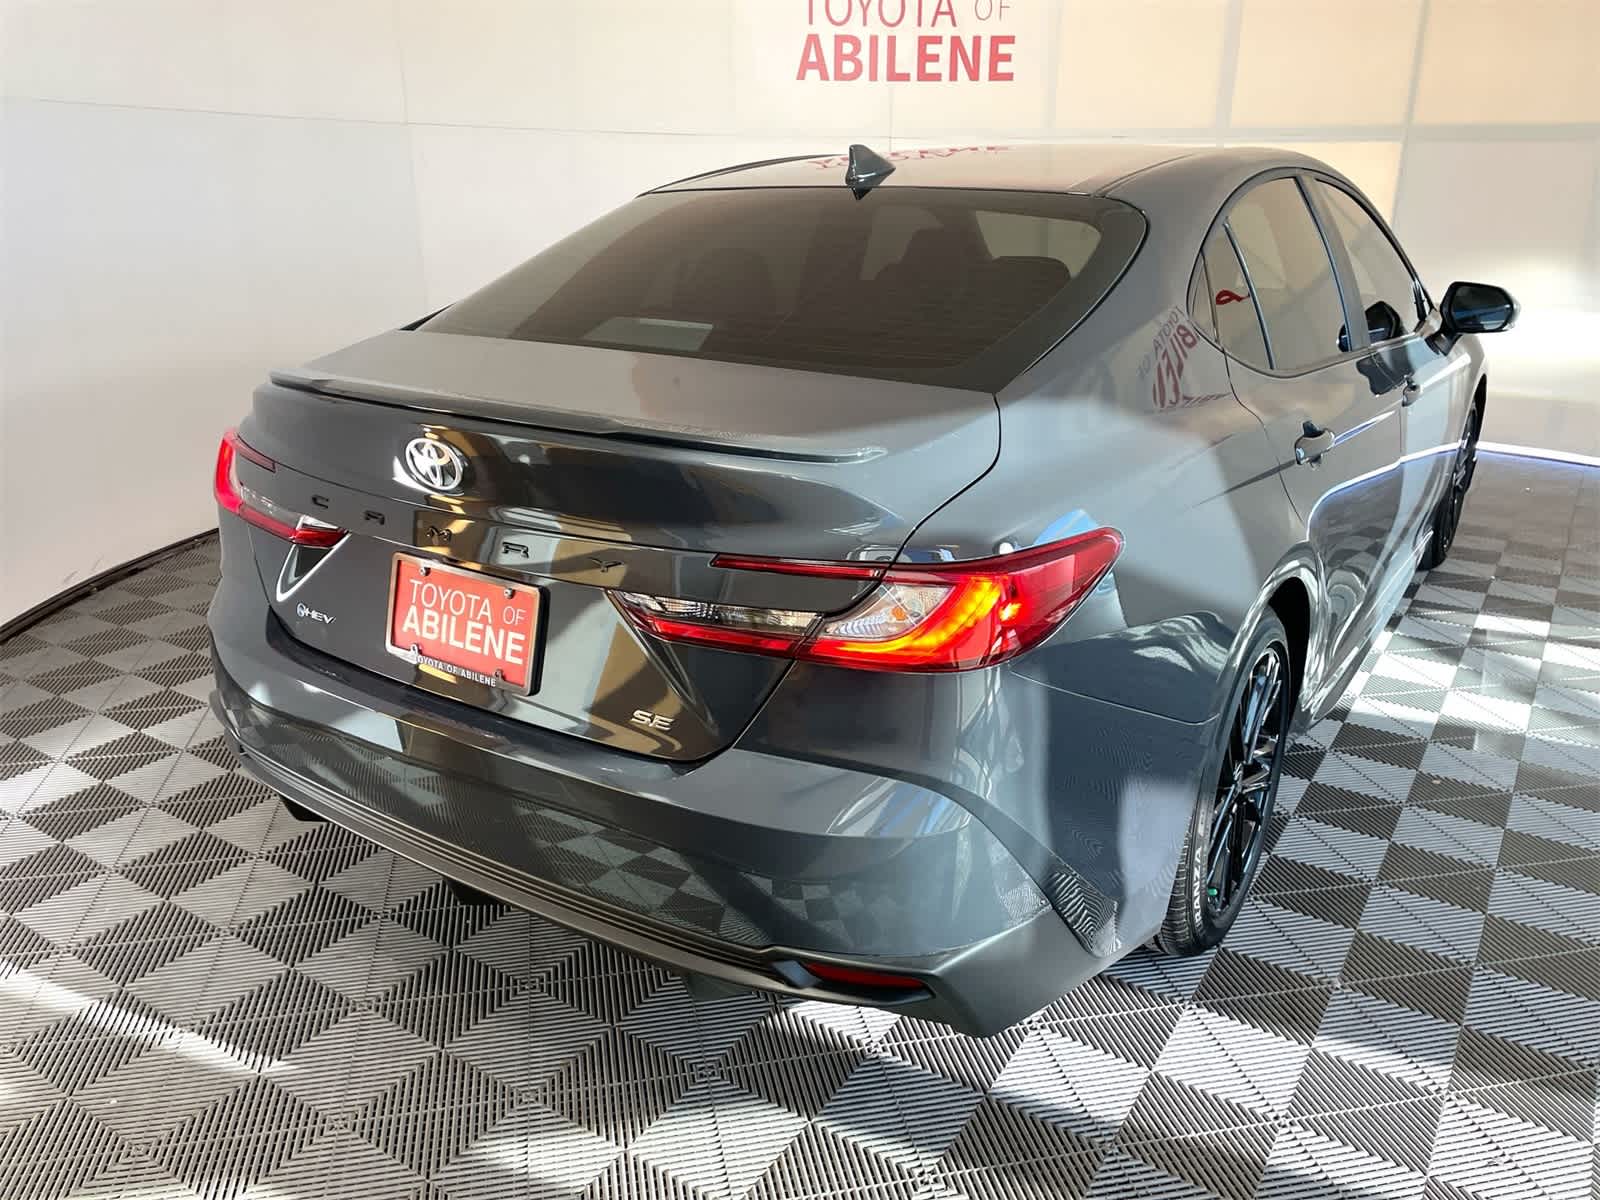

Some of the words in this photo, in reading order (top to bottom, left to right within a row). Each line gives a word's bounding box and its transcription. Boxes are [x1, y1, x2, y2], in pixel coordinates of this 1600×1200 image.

[807, 0, 957, 28] TOYOTA
[974, 0, 1010, 21] OF
[795, 33, 1016, 82] ABILENE
[312, 494, 623, 573] CAMRY
[305, 607, 335, 624] HEV
[410, 578, 492, 624] TOYOTA
[503, 605, 526, 626] OF
[402, 604, 525, 665] ABILENE
[415, 654, 444, 670] OYOTA
[446, 663, 459, 675] OF
[460, 668, 497, 688] ABILENE
[631, 709, 675, 731] SE
